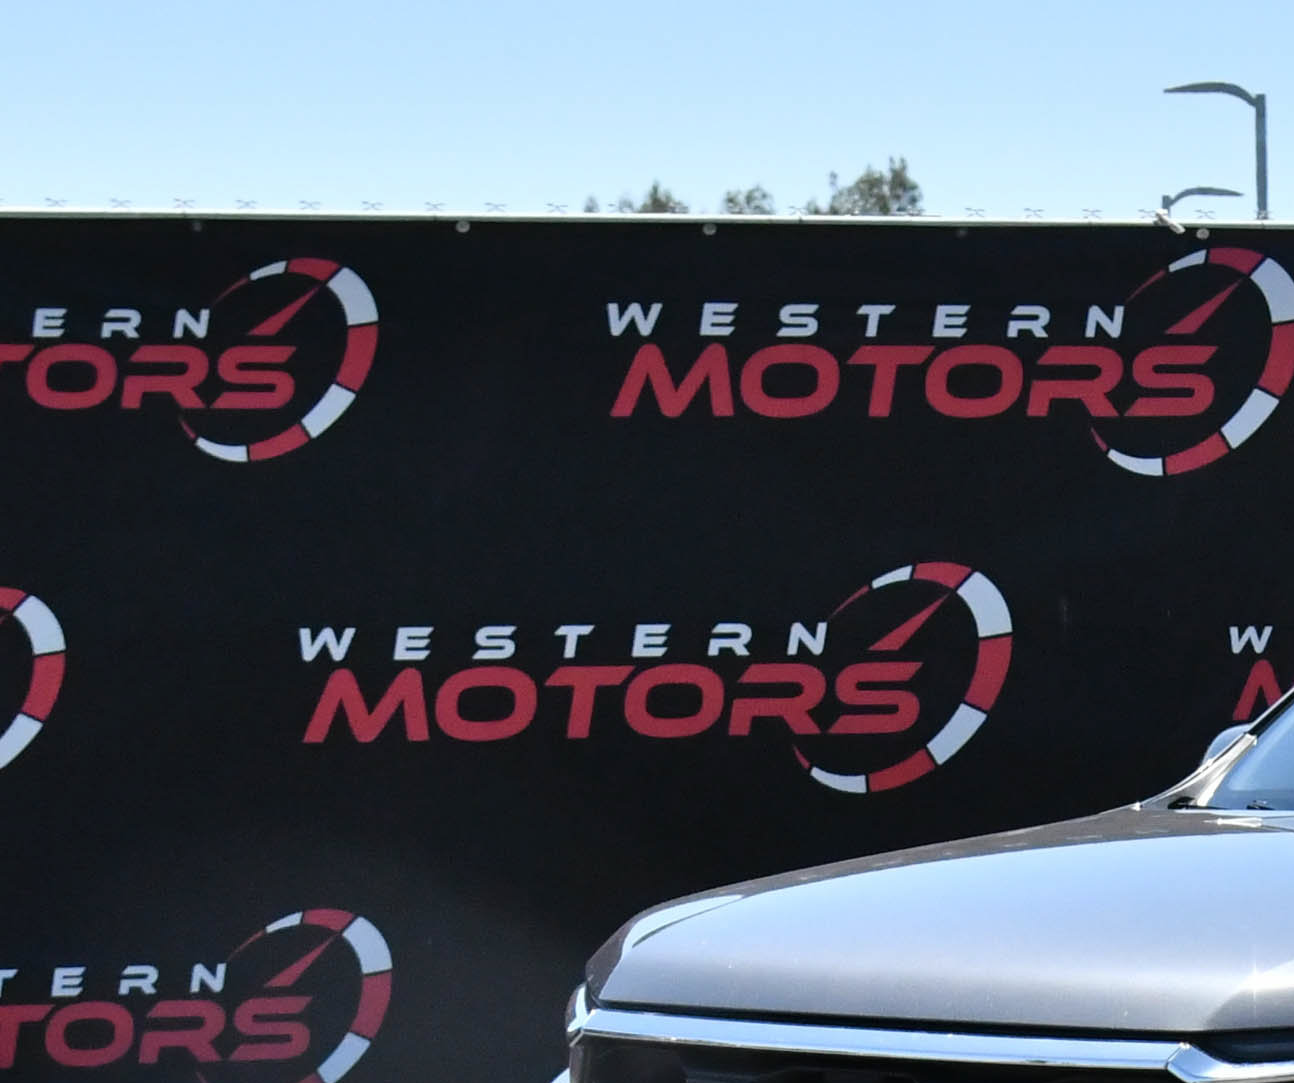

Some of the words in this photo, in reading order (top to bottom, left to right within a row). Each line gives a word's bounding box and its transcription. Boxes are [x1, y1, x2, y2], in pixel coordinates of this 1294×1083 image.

[607, 302, 1124, 338] WESTERN
[611, 343, 1217, 419] MOTORS
[299, 622, 828, 662] WESTERN
[303, 661, 921, 744] MOTORS
